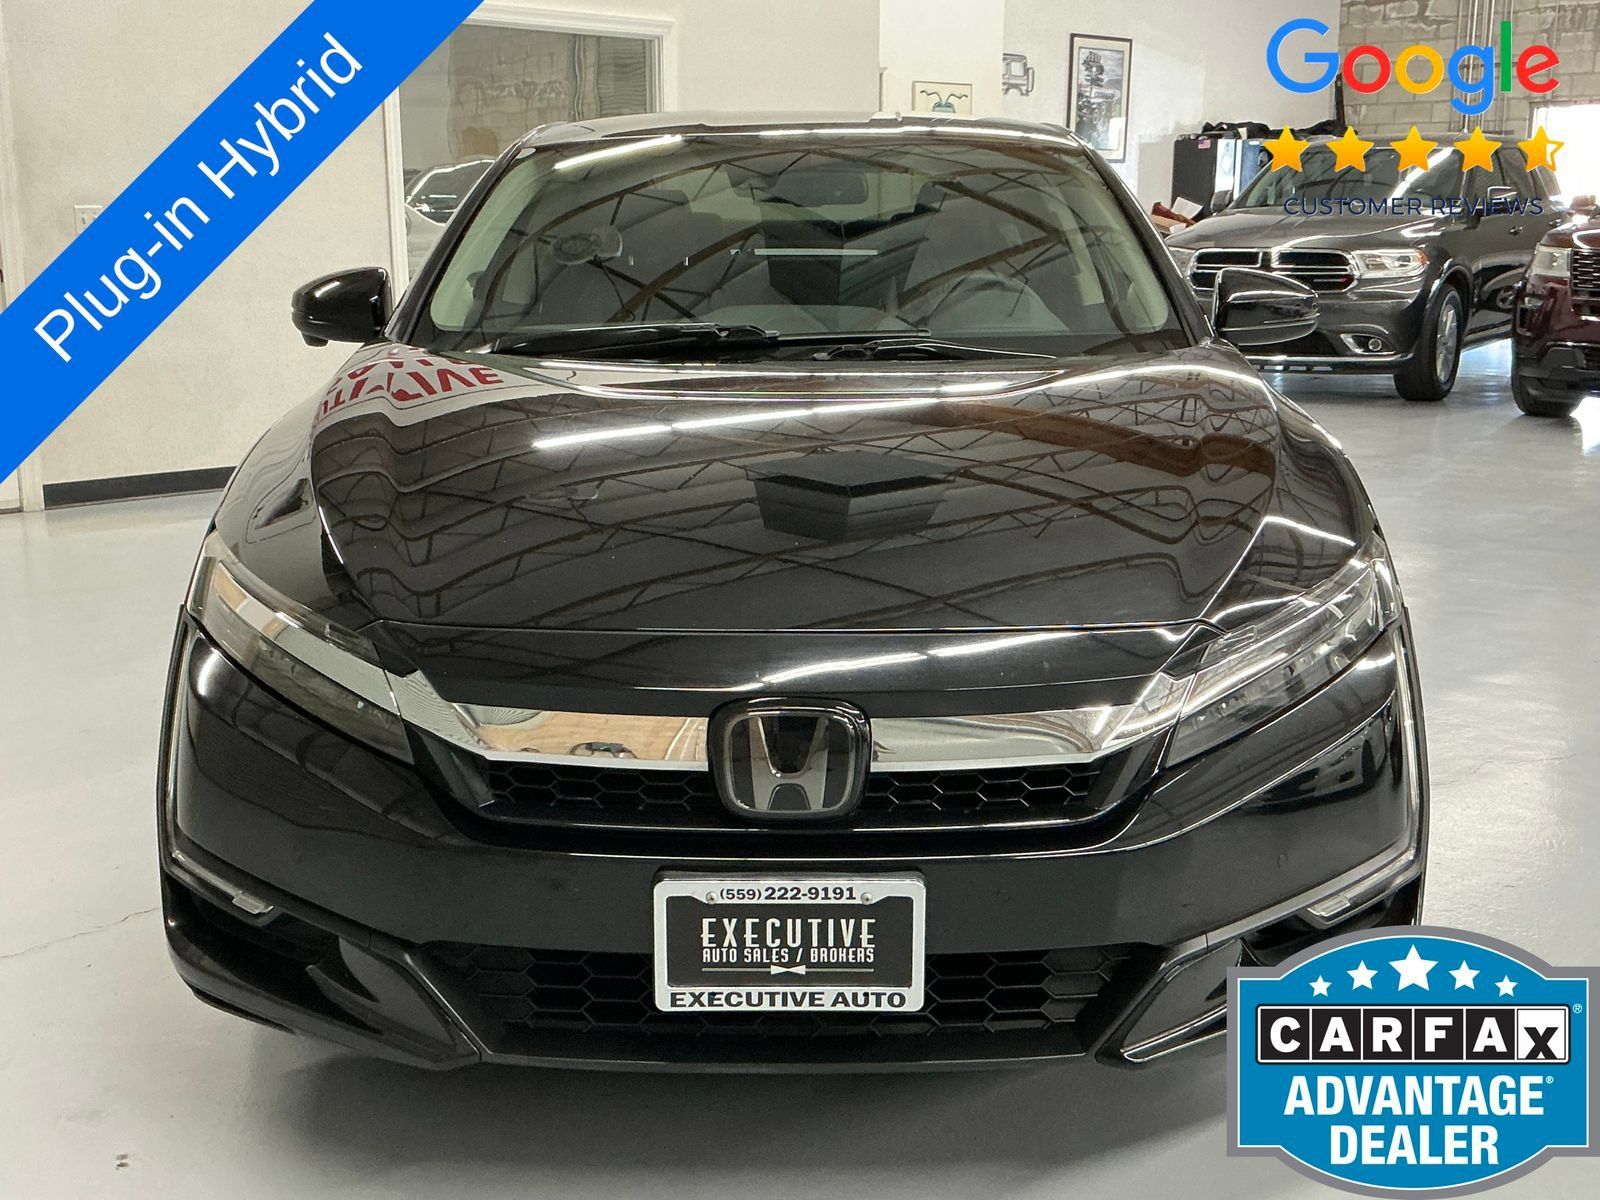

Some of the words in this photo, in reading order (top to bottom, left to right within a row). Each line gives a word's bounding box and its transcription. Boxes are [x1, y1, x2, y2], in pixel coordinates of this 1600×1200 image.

[719, 888, 762, 901] (559)
[764, 886, 856, 901] 222-9191
[701, 918, 876, 948] EXECUTIVE
[702, 948, 737, 963] AUTO
[743, 948, 789, 963] SALES
[810, 948, 875, 963] BROKERS
[670, 991, 825, 1008] EXECUTIVE
[830, 991, 906, 1008] AUTO
